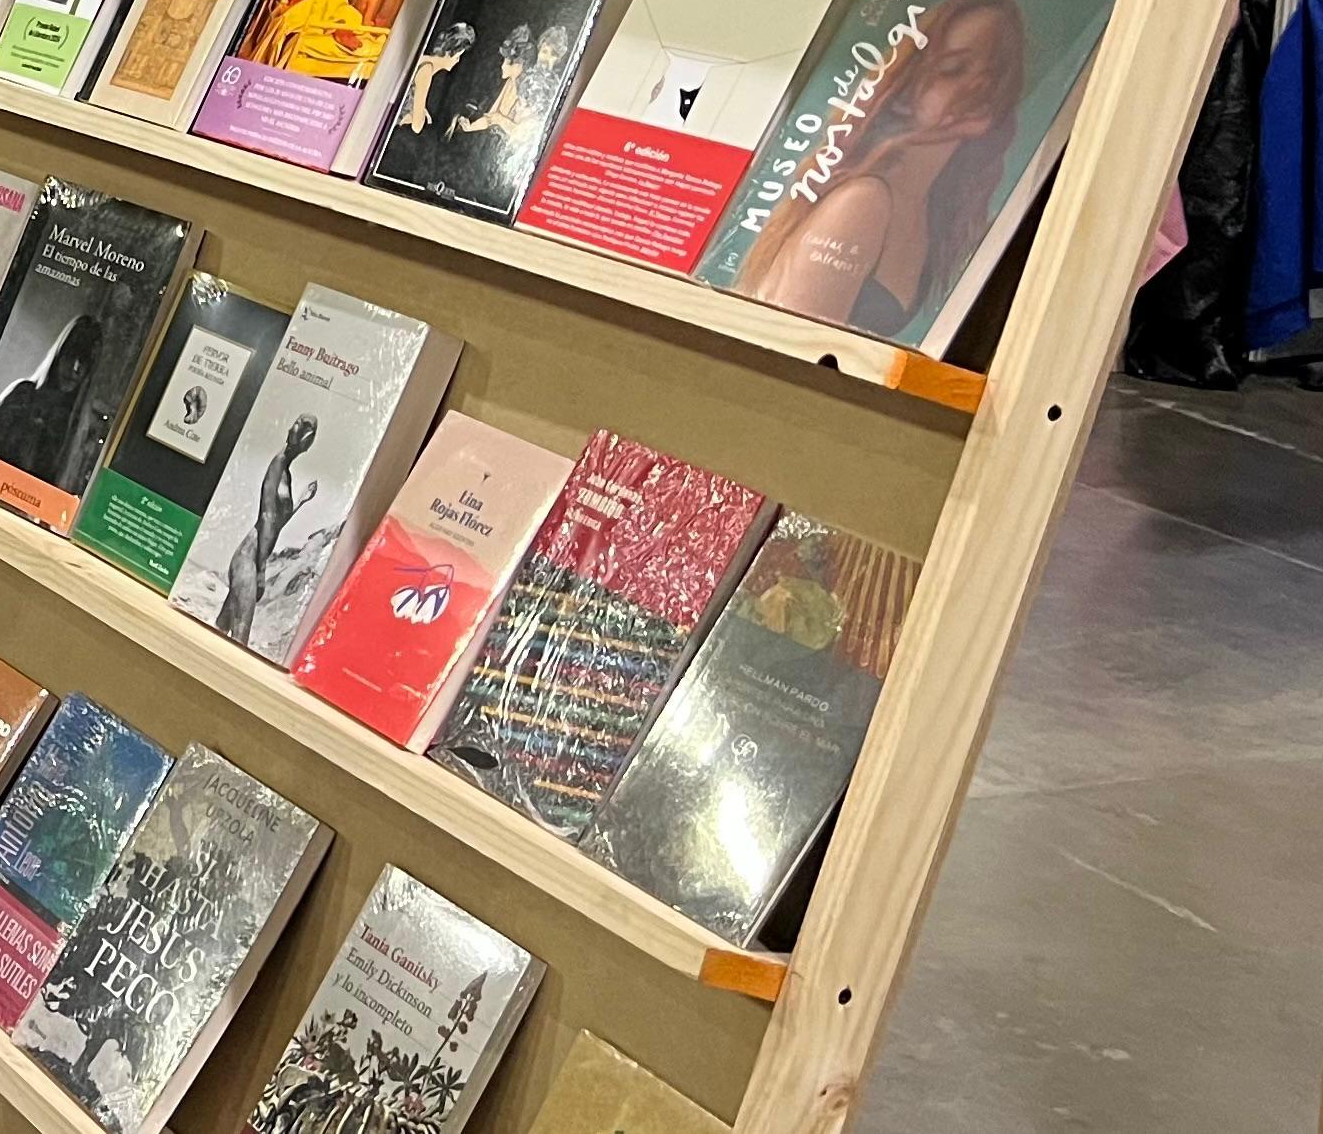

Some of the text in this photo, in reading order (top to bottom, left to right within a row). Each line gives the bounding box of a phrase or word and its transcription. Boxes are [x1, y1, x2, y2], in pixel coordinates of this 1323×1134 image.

[221, 65, 242, 85] 60
[832, 62, 861, 97] de
[740, 113, 824, 234] MUSEO
[42, 243, 118, 284] El tiempo de las
[49, 224, 145, 273] Marvel Moreno
[34, 263, 82, 288] amazonas
[276, 357, 333, 390] Bello animal
[286, 336, 360, 377] Fanny Buitrago
[430, 497, 459, 521] Rojas
[458, 510, 494, 537] Flórez
[458, 490, 484, 511] Lina
[789, 687, 830, 712] PARDO
[202, 773, 283, 834] JACQUELINE
[205, 804, 257, 845] URZOLA
[139, 862, 223, 942] HASTA
[27, 939, 55, 977] SON
[360, 923, 443, 993] Tania Ganitsky
[345, 947, 433, 1019] Emily Dickinson
[342, 974, 355, 996] lo
[353, 987, 414, 1037] incompleto
